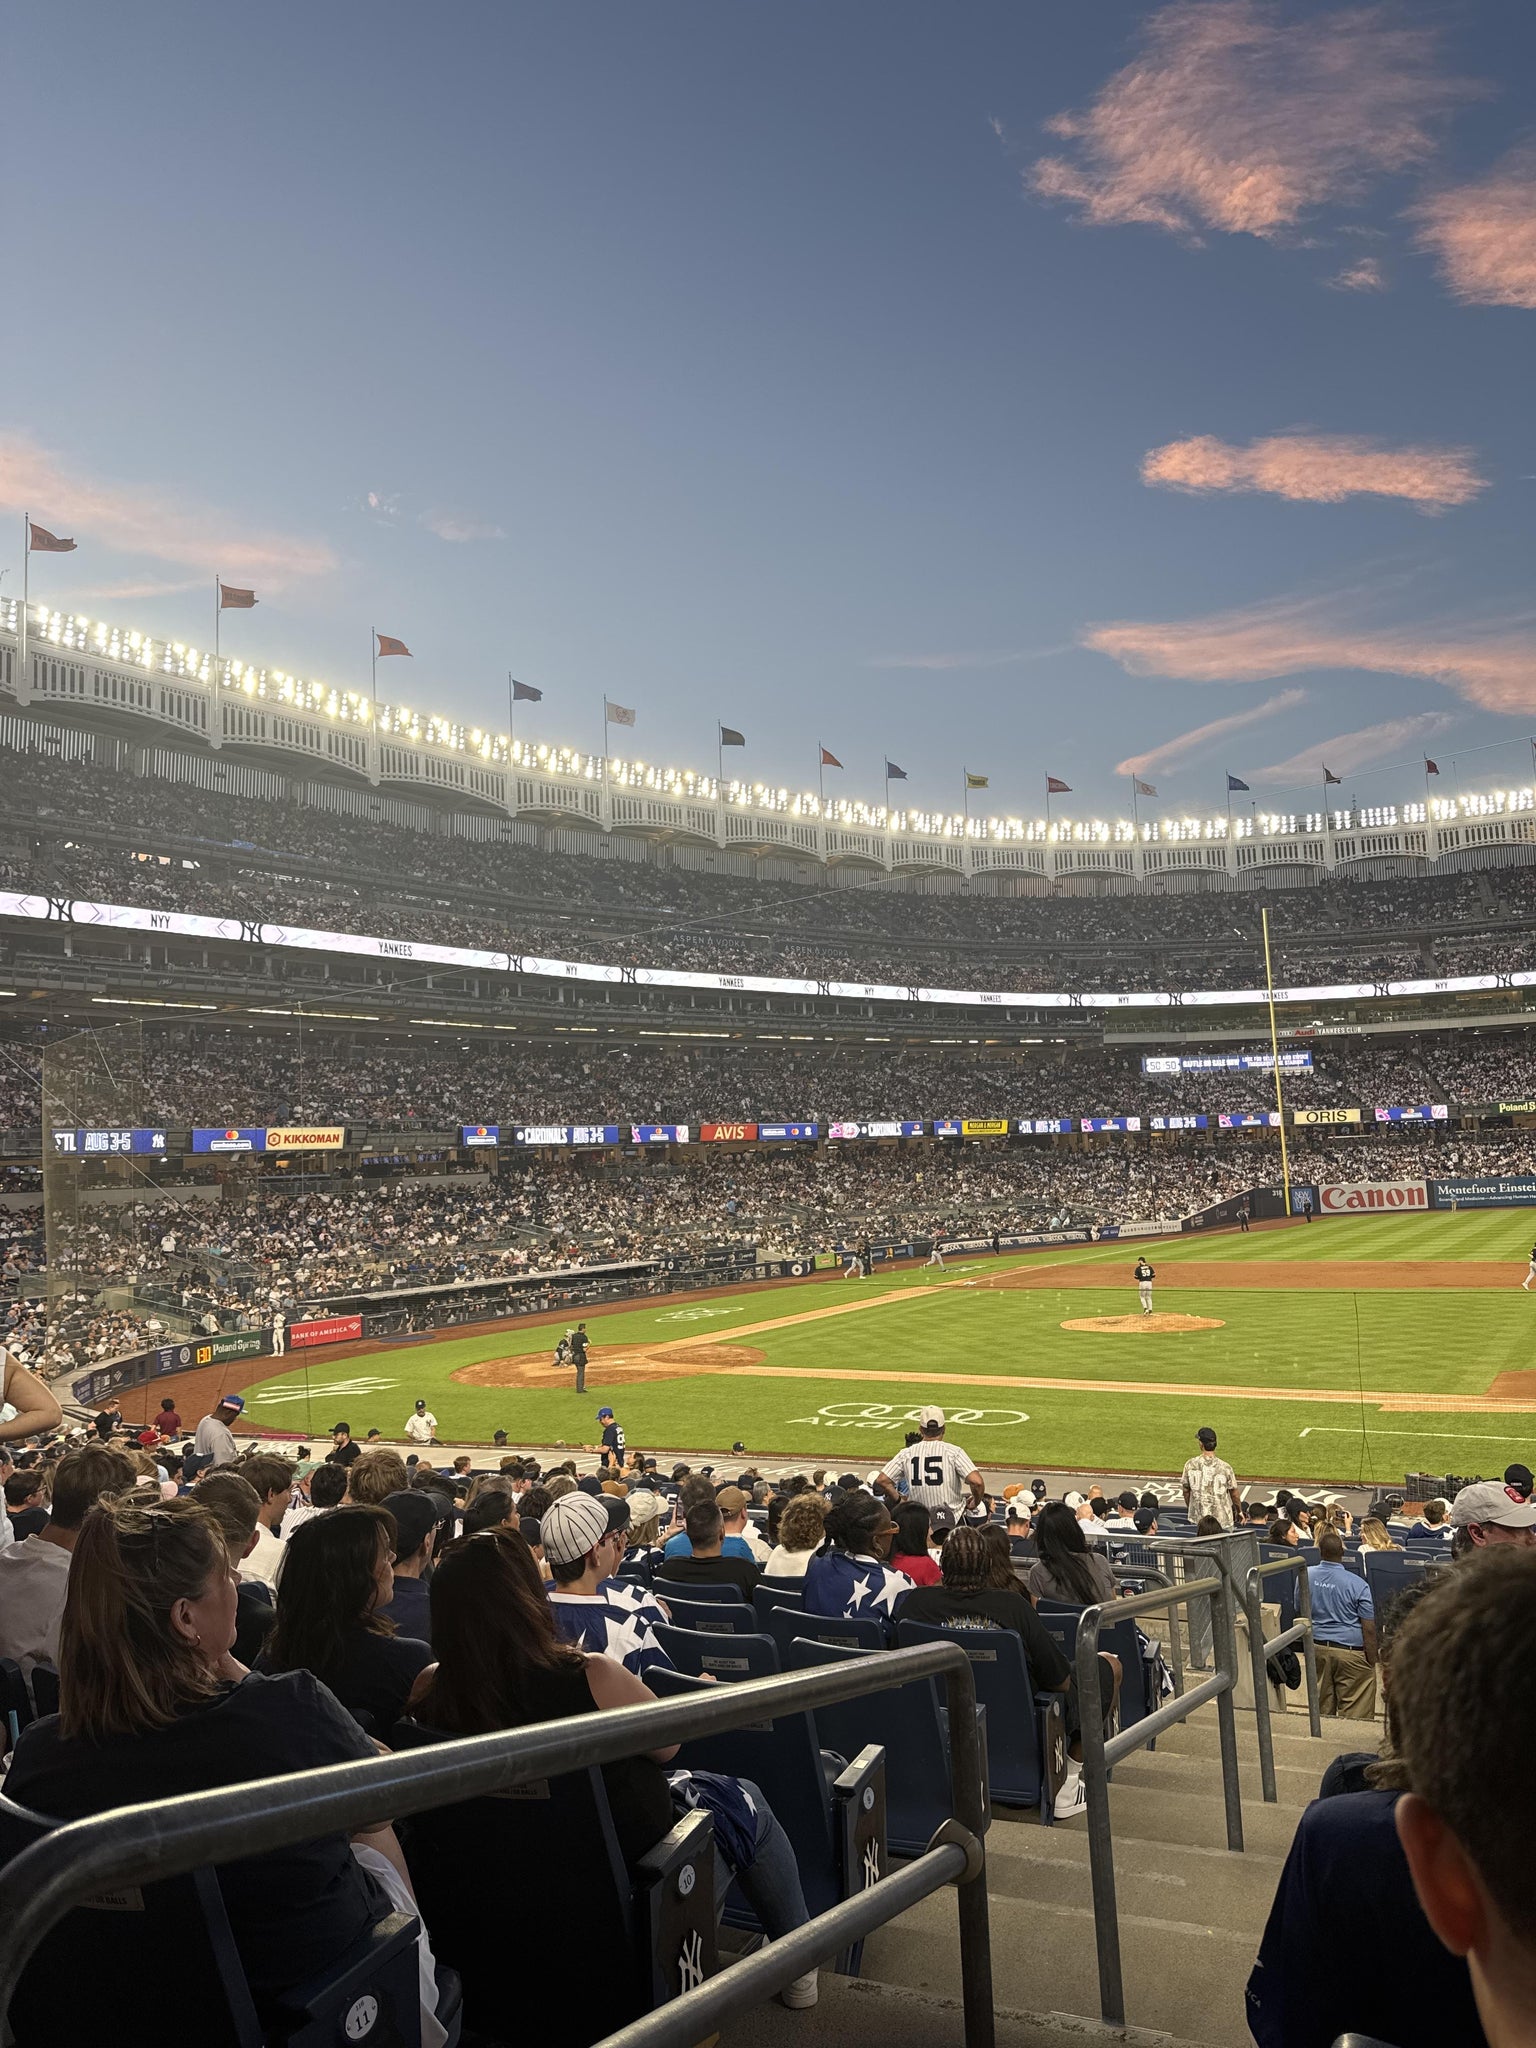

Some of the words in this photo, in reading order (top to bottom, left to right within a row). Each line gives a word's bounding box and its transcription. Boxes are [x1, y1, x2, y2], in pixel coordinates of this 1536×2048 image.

[151, 914, 171, 929] NYY
[673, 934, 704, 944] ASPEN
[716, 938, 746, 948] VODKA
[379, 942, 412, 957] YANKEES
[566, 965, 578, 976] NYY
[719, 977, 744, 988] YANKEES
[1435, 982, 1448, 990] NYY
[980, 994, 1002, 1004] YANKEES
[1294, 1028, 1316, 1036] Audi
[1318, 1027, 1346, 1035] YANKEES
[1499, 1102, 1527, 1113] Poland
[1306, 1110, 1347, 1122] ORIS
[284, 1134, 340, 1144] KIKKOMAN
[525, 1127, 568, 1144] CARDINALS
[714, 1126, 745, 1139] AVIS
[85, 1133, 108, 1151] AUG
[110, 1133, 131, 1151] 3-5
[1438, 1184, 1496, 1195] Montefiore
[1321, 1187, 1425, 1209] Canon
[1141, 1269, 1151, 1277] 59
[291, 1331, 309, 1340] BANK
[319, 1326, 348, 1336] AMERICA
[213, 1341, 237, 1355] Poland
[786, 1416, 905, 1430] Audi
[911, 1456, 943, 1486] 15
[683, 1873, 692, 1890] 10
[106, 1896, 127, 1905] BALLS
[355, 2010, 370, 2032] 11
